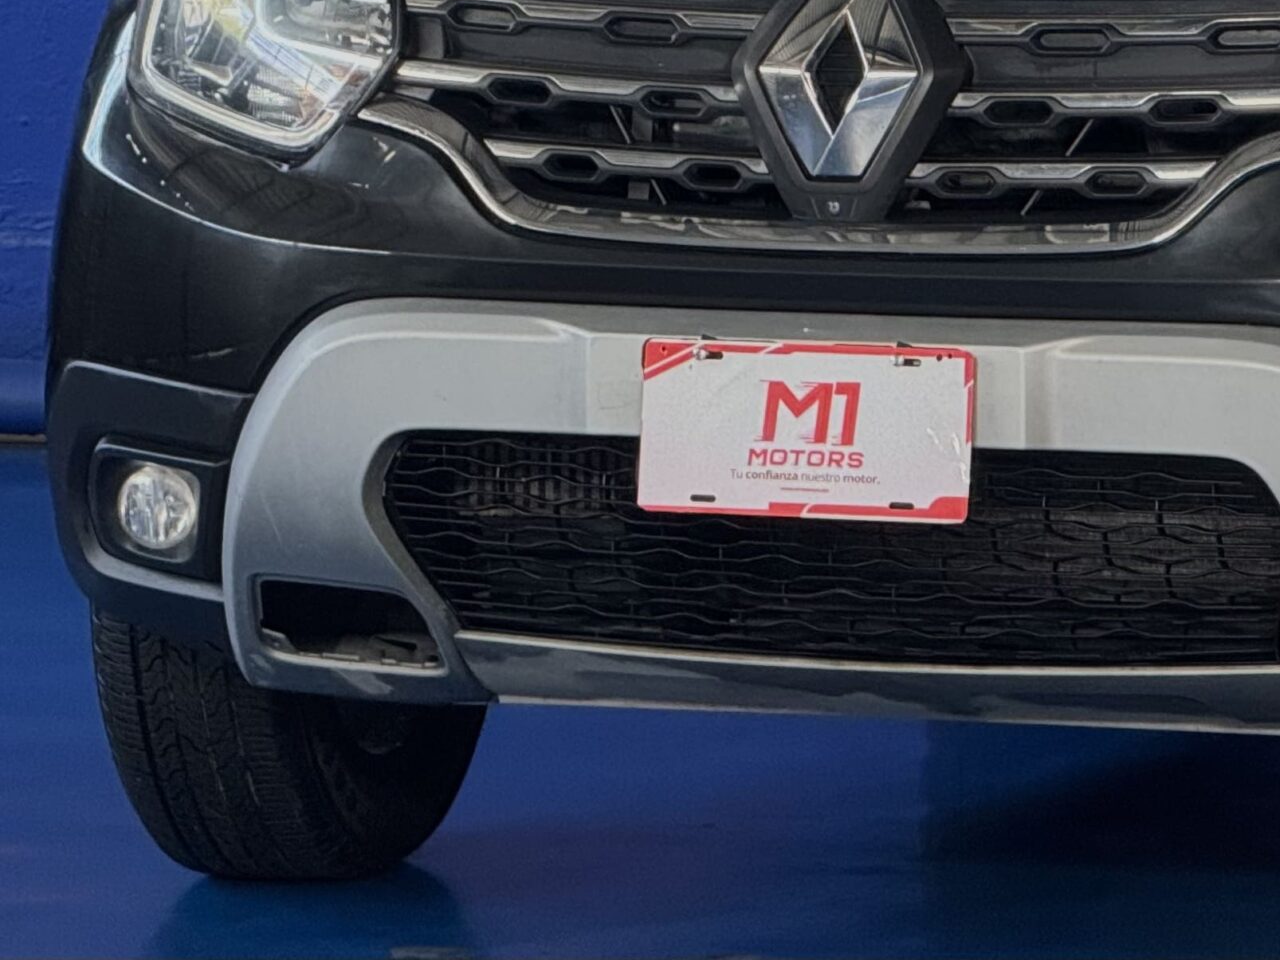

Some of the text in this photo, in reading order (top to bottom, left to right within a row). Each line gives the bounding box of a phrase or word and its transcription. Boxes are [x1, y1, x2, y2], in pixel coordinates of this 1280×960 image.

[754, 379, 861, 446] M1
[747, 448, 864, 469] MOTORS
[730, 468, 743, 480] Tu
[745, 470, 799, 481] confianza
[801, 472, 841, 483] nuestro
